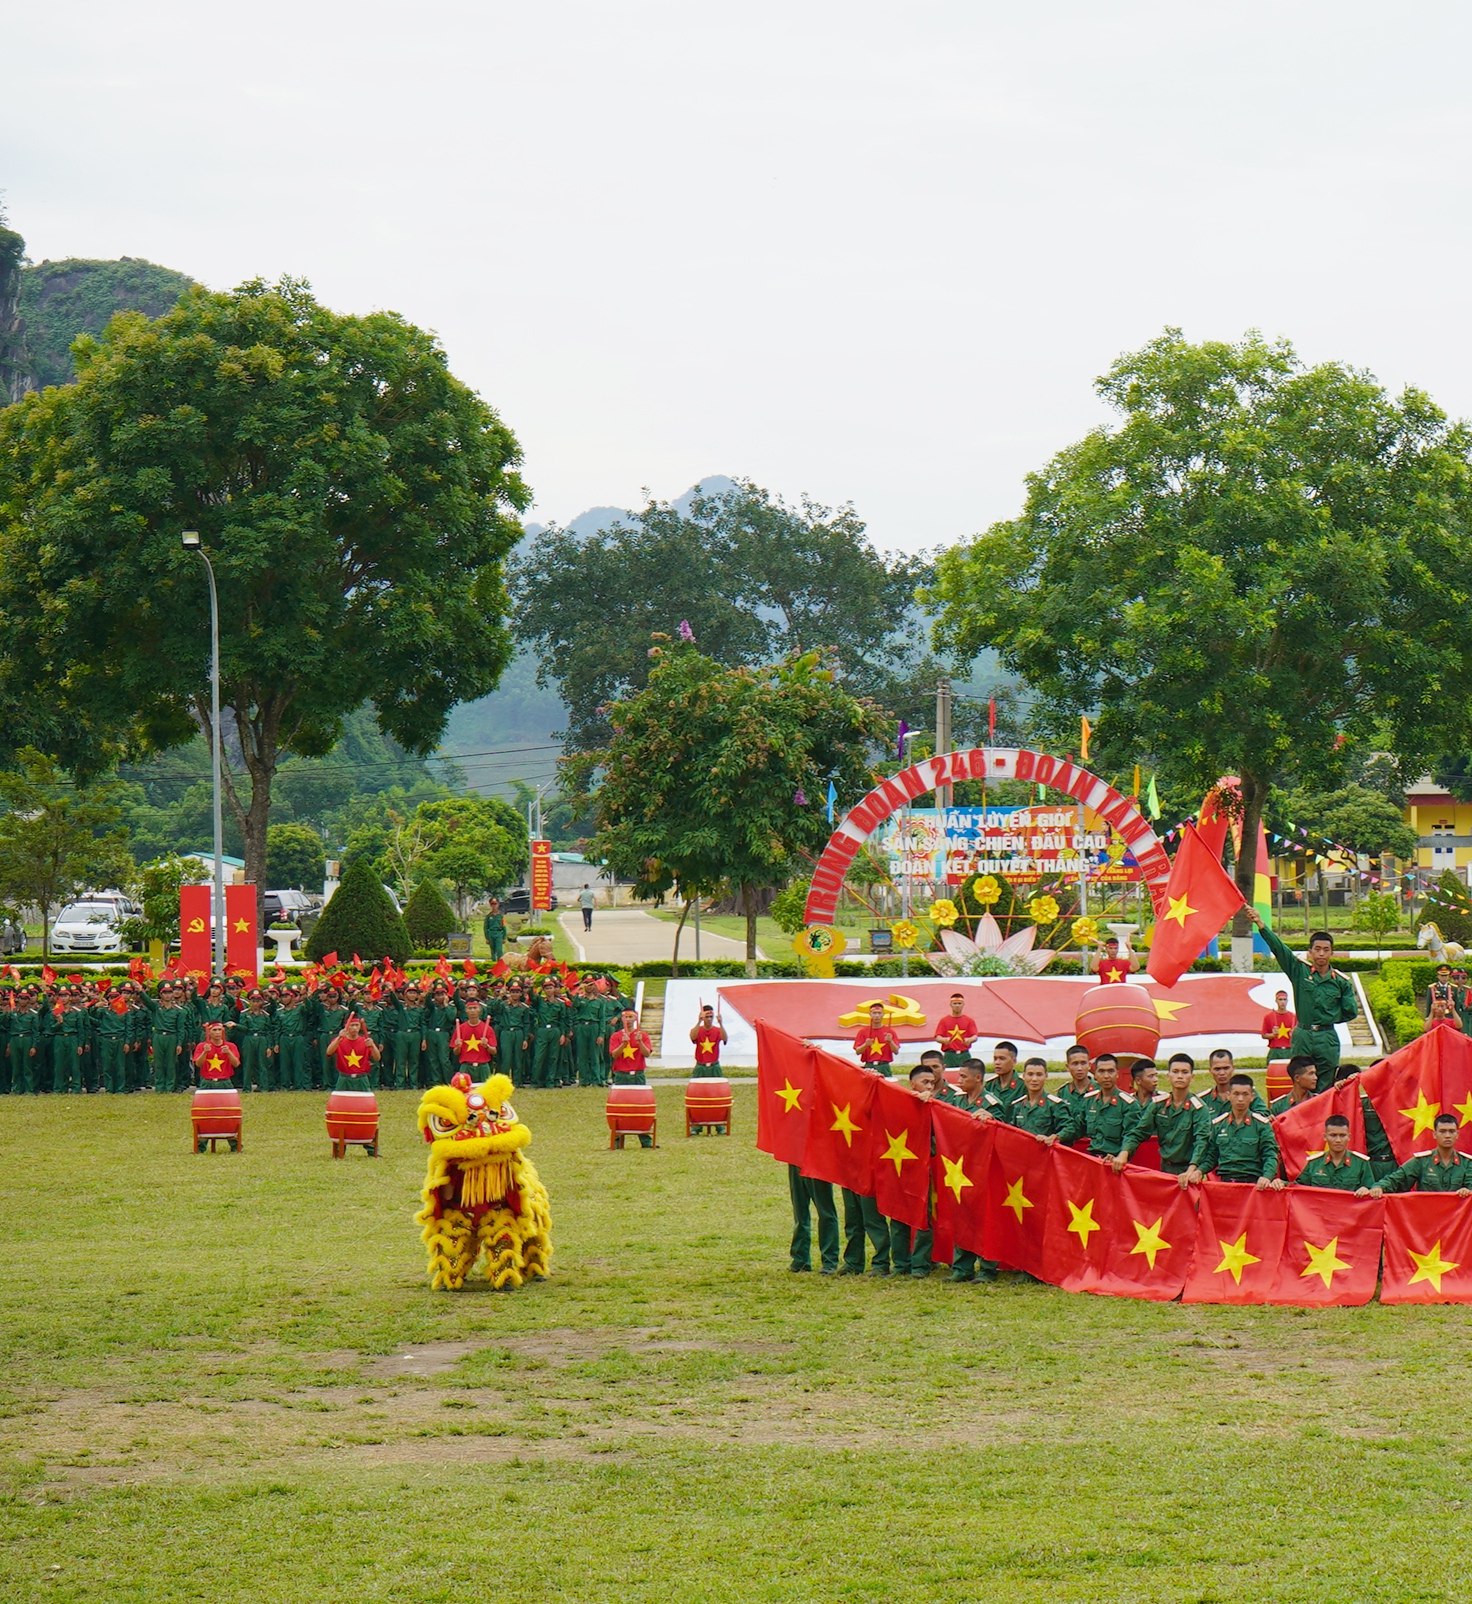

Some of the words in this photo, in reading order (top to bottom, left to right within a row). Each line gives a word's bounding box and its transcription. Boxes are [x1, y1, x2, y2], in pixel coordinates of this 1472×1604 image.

[803, 831, 863, 924] TRUNG
[930, 748, 987, 787] 246
[1014, 750, 1098, 803] ĐOÀN
[1095, 787, 1152, 846] TÂN
[1072, 834, 1106, 850] CAO
